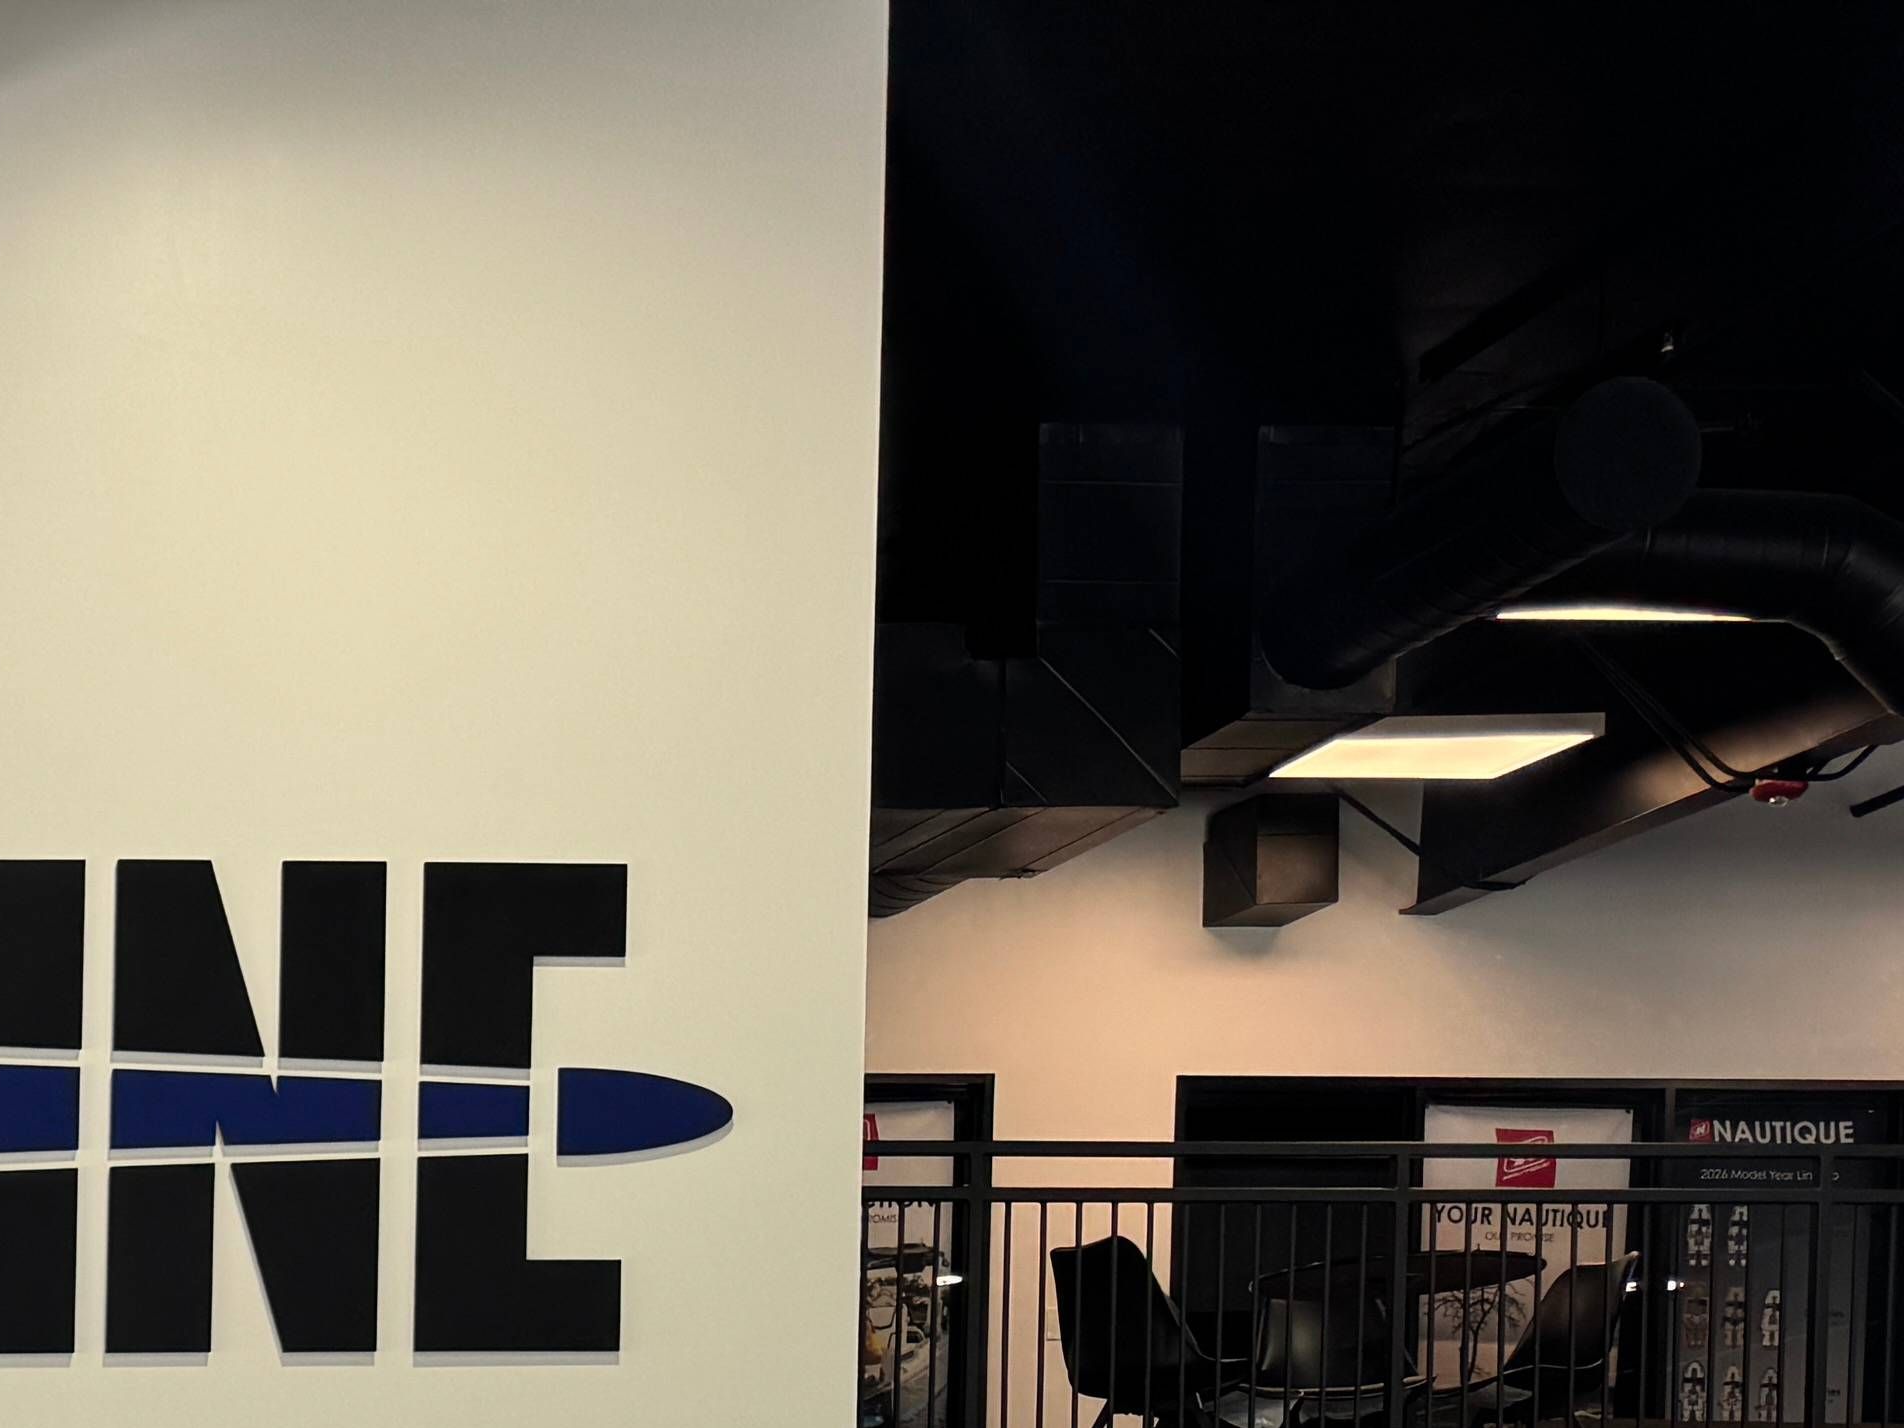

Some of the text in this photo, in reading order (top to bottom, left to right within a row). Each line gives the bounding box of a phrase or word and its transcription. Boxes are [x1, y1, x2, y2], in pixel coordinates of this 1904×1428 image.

[1712, 1119, 1855, 1144] NAUTIQUE
[1730, 1168, 1767, 1180] Model
[1769, 1170, 1794, 1181] Year
[1435, 1205, 1492, 1225] YOUR
[1510, 1231, 1555, 1243] PROSE
